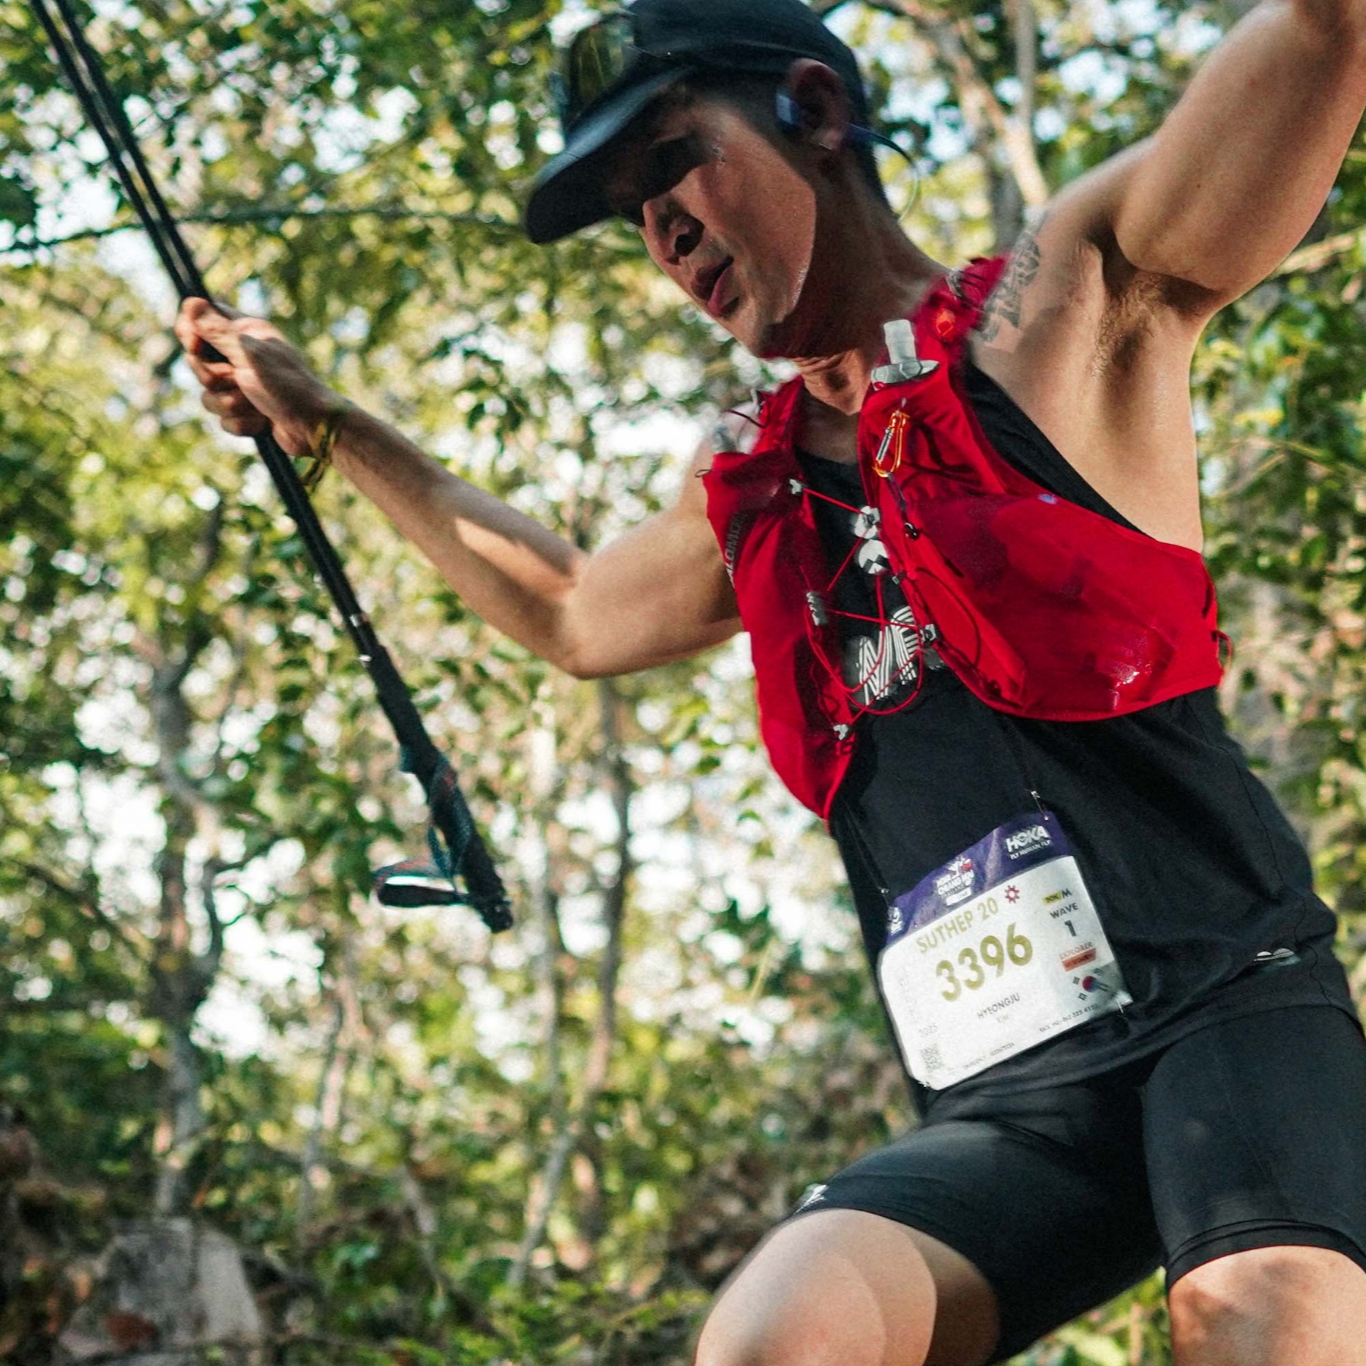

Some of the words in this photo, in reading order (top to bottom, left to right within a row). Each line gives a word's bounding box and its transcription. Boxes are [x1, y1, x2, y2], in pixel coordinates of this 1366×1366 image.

[1006, 825, 1050, 852] HOKA
[1050, 902, 1079, 919] WAVE
[916, 910, 974, 954] SUTHEP
[978, 897, 999, 921] 20
[1064, 920, 1077, 937] 1
[936, 922, 1034, 1002] 3396
[977, 992, 1021, 1020] HYEONGJU
